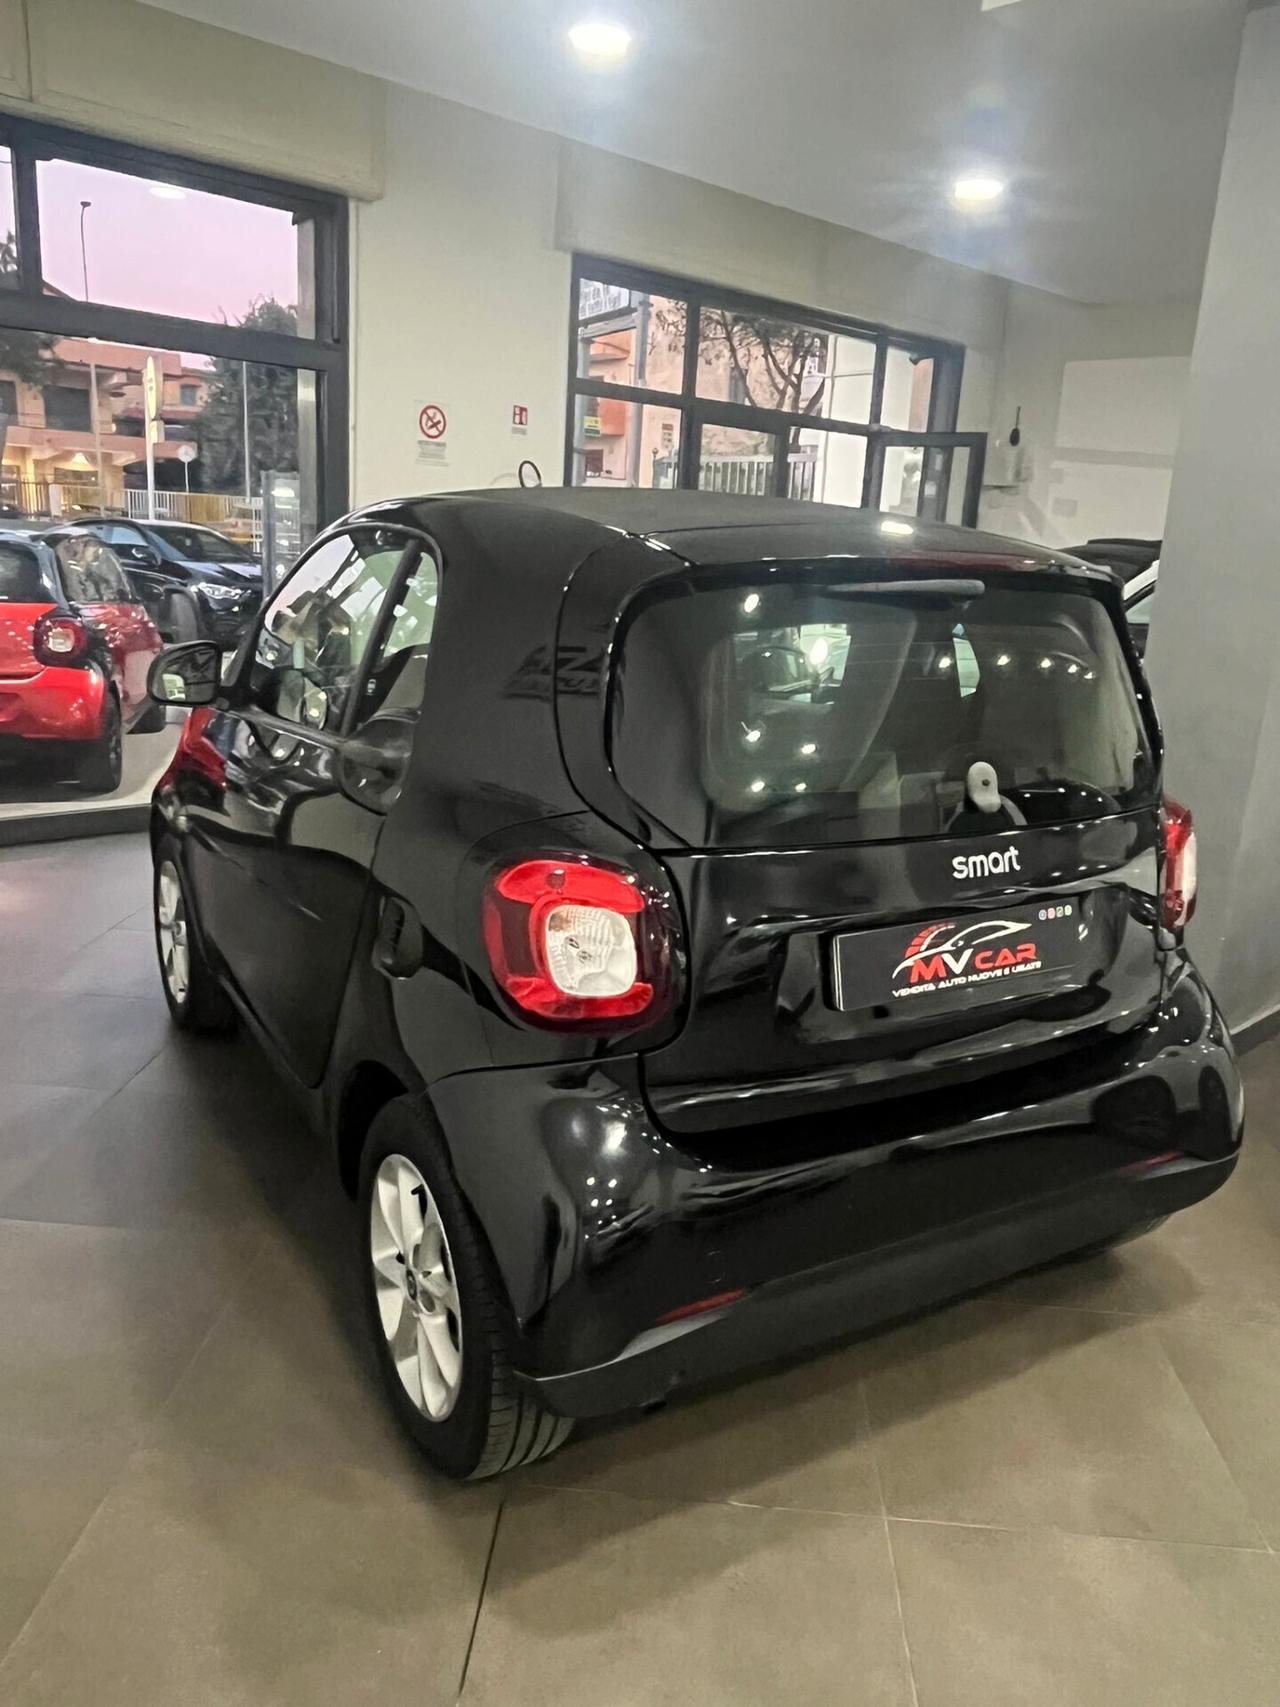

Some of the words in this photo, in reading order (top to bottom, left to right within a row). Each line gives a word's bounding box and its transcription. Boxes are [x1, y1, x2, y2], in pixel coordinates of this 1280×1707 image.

[952, 846, 1021, 879] smart
[975, 943, 1037, 969] CAR
[938, 976, 967, 989] AUTO
